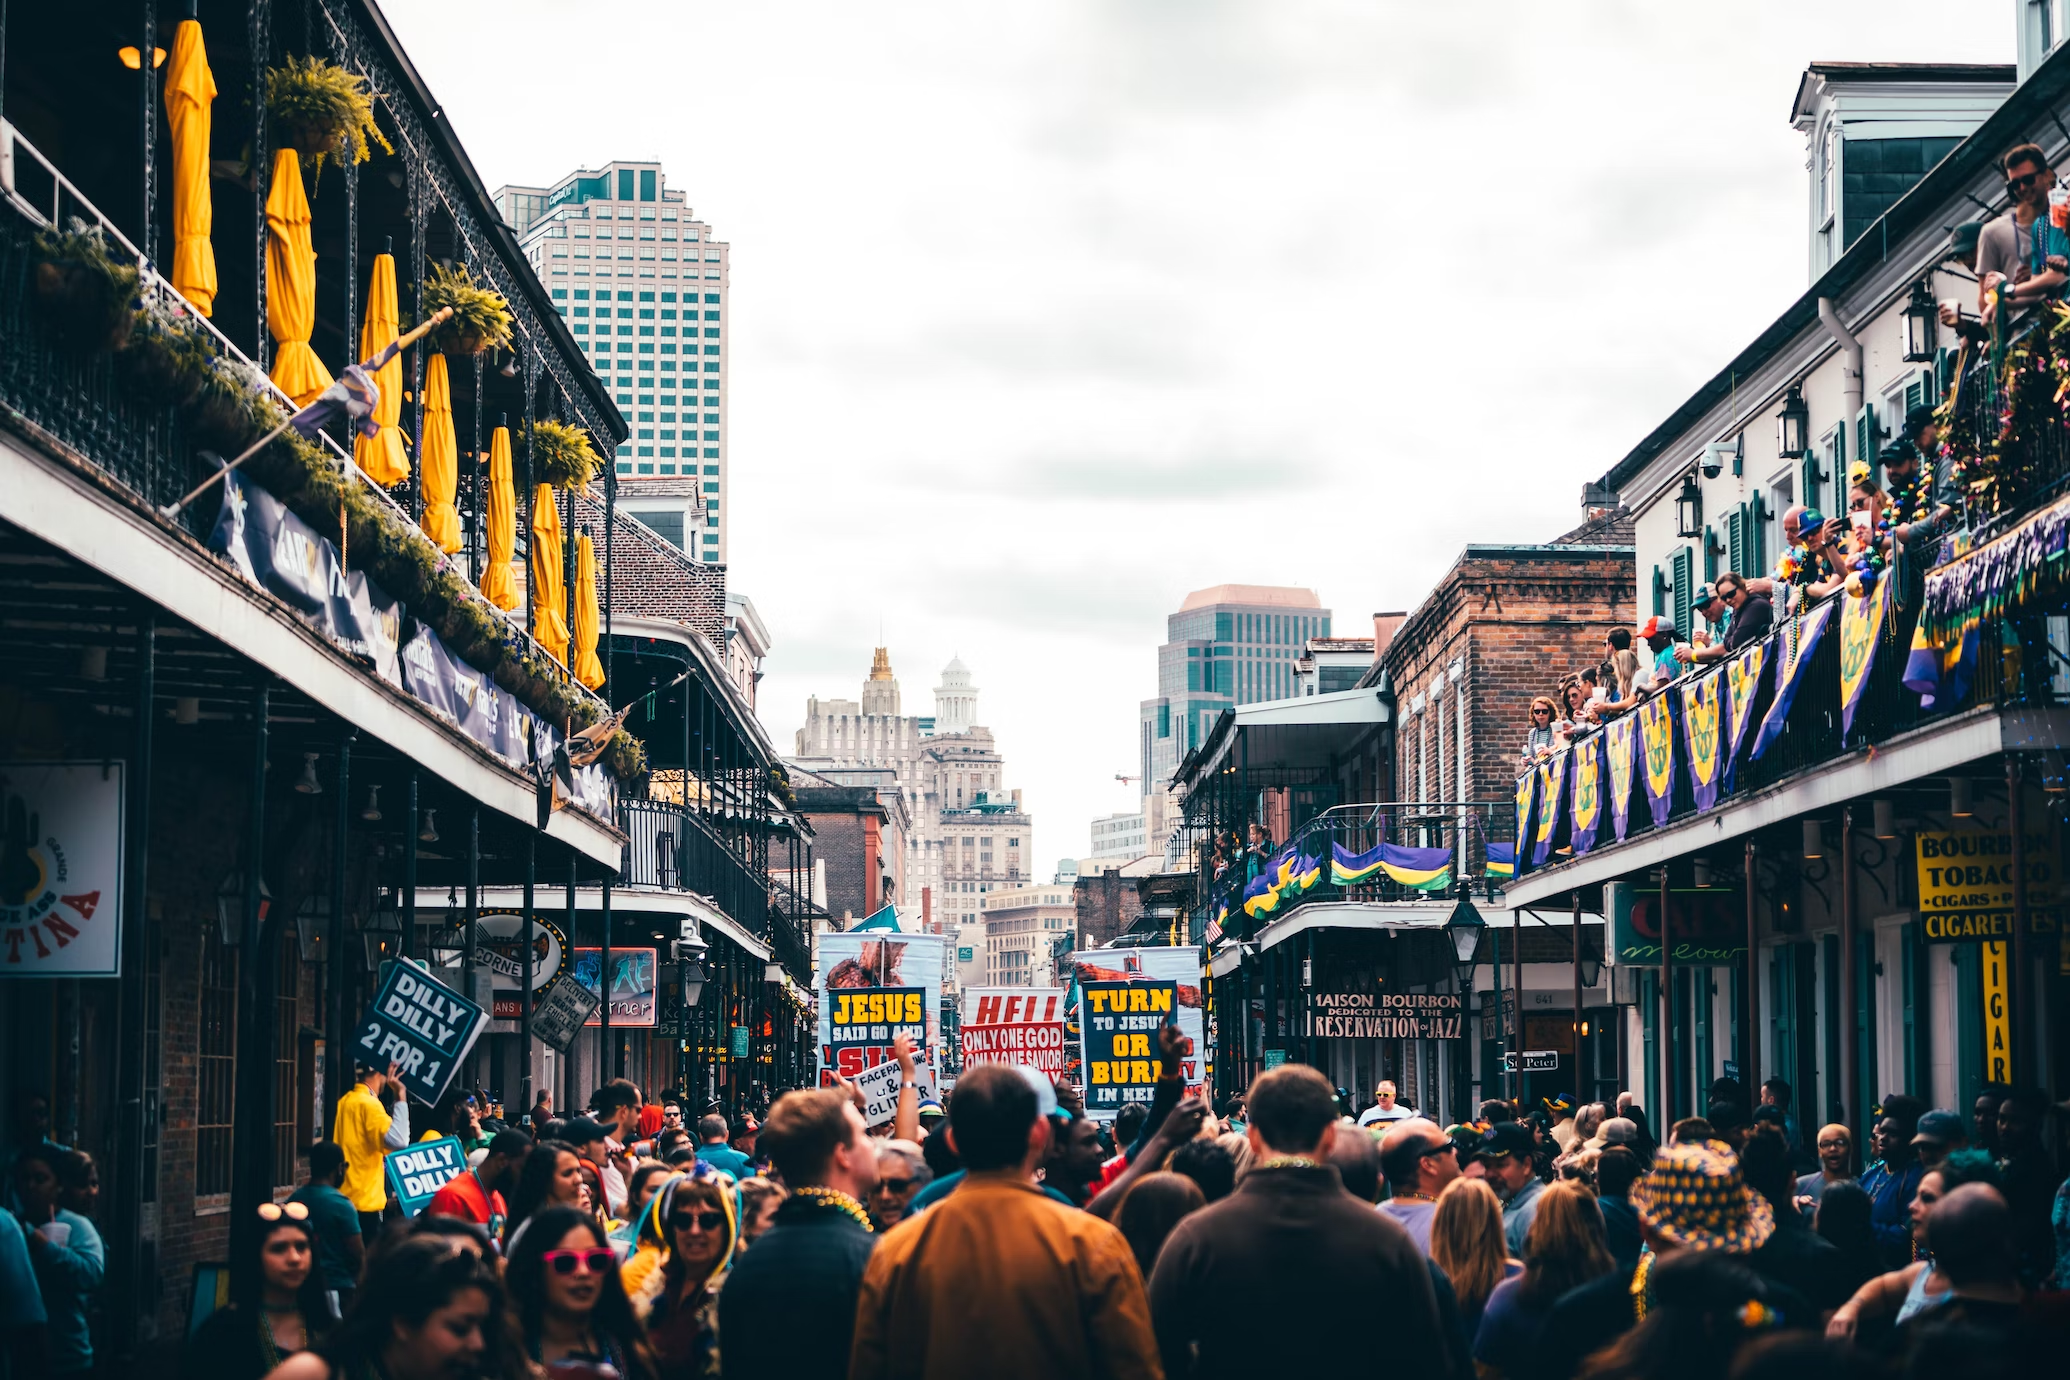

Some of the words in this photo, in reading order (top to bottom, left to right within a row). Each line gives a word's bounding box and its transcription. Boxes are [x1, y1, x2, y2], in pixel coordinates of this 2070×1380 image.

[46, 836, 68, 883] GRANDE
[1932, 893, 1990, 907] CIGARS
[1926, 911, 2056, 938] CIGARETES
[474, 947, 523, 976] CORNE
[1622, 943, 1748, 960] meow
[395, 972, 467, 1025] DILLY
[560, 978, 593, 1007] DELIVERY
[564, 995, 577, 1007] AND
[1087, 989, 1172, 1013] TURN
[1382, 994, 1462, 1008] BOURBON
[1536, 994, 1553, 1004] 641
[493, 1002, 515, 1013] ANS
[544, 1002, 577, 1032] VEHICLES
[551, 995, 580, 1022] SERVICE
[834, 993, 922, 1024] JESUS
[1328, 1008, 1392, 1016] DEDICATED
[1398, 1008, 1414, 1016] TO
[1420, 1009, 1443, 1017] THE
[384, 994, 456, 1046] DILLY
[543, 1017, 564, 1035] ONLY
[1093, 1016, 1114, 1030] TO
[1426, 1013, 1462, 1038] JAZZ
[832, 1026, 867, 1041] SAID
[871, 1025, 888, 1039] GO
[892, 1024, 923, 1039] AND
[963, 1029, 999, 1052] ONLY
[1000, 1028, 1024, 1049] ONE
[1025, 1027, 1061, 1048] GOD
[360, 1022, 381, 1049] 2
[377, 1031, 425, 1077] FOR
[421, 1060, 441, 1087] 1
[1112, 1034, 1150, 1057] OR
[837, 1046, 918, 1078] SI
[859, 1054, 926, 1087] FACEPAING
[1026, 1049, 1062, 1070] SAVIOR
[1526, 1057, 1555, 1068] Peter
[888, 1078, 899, 1093] &
[1097, 1088, 1117, 1102] IN
[1122, 1087, 1155, 1102] HEL
[868, 1086, 930, 1116] GLITR
[395, 1145, 453, 1176] DILLY
